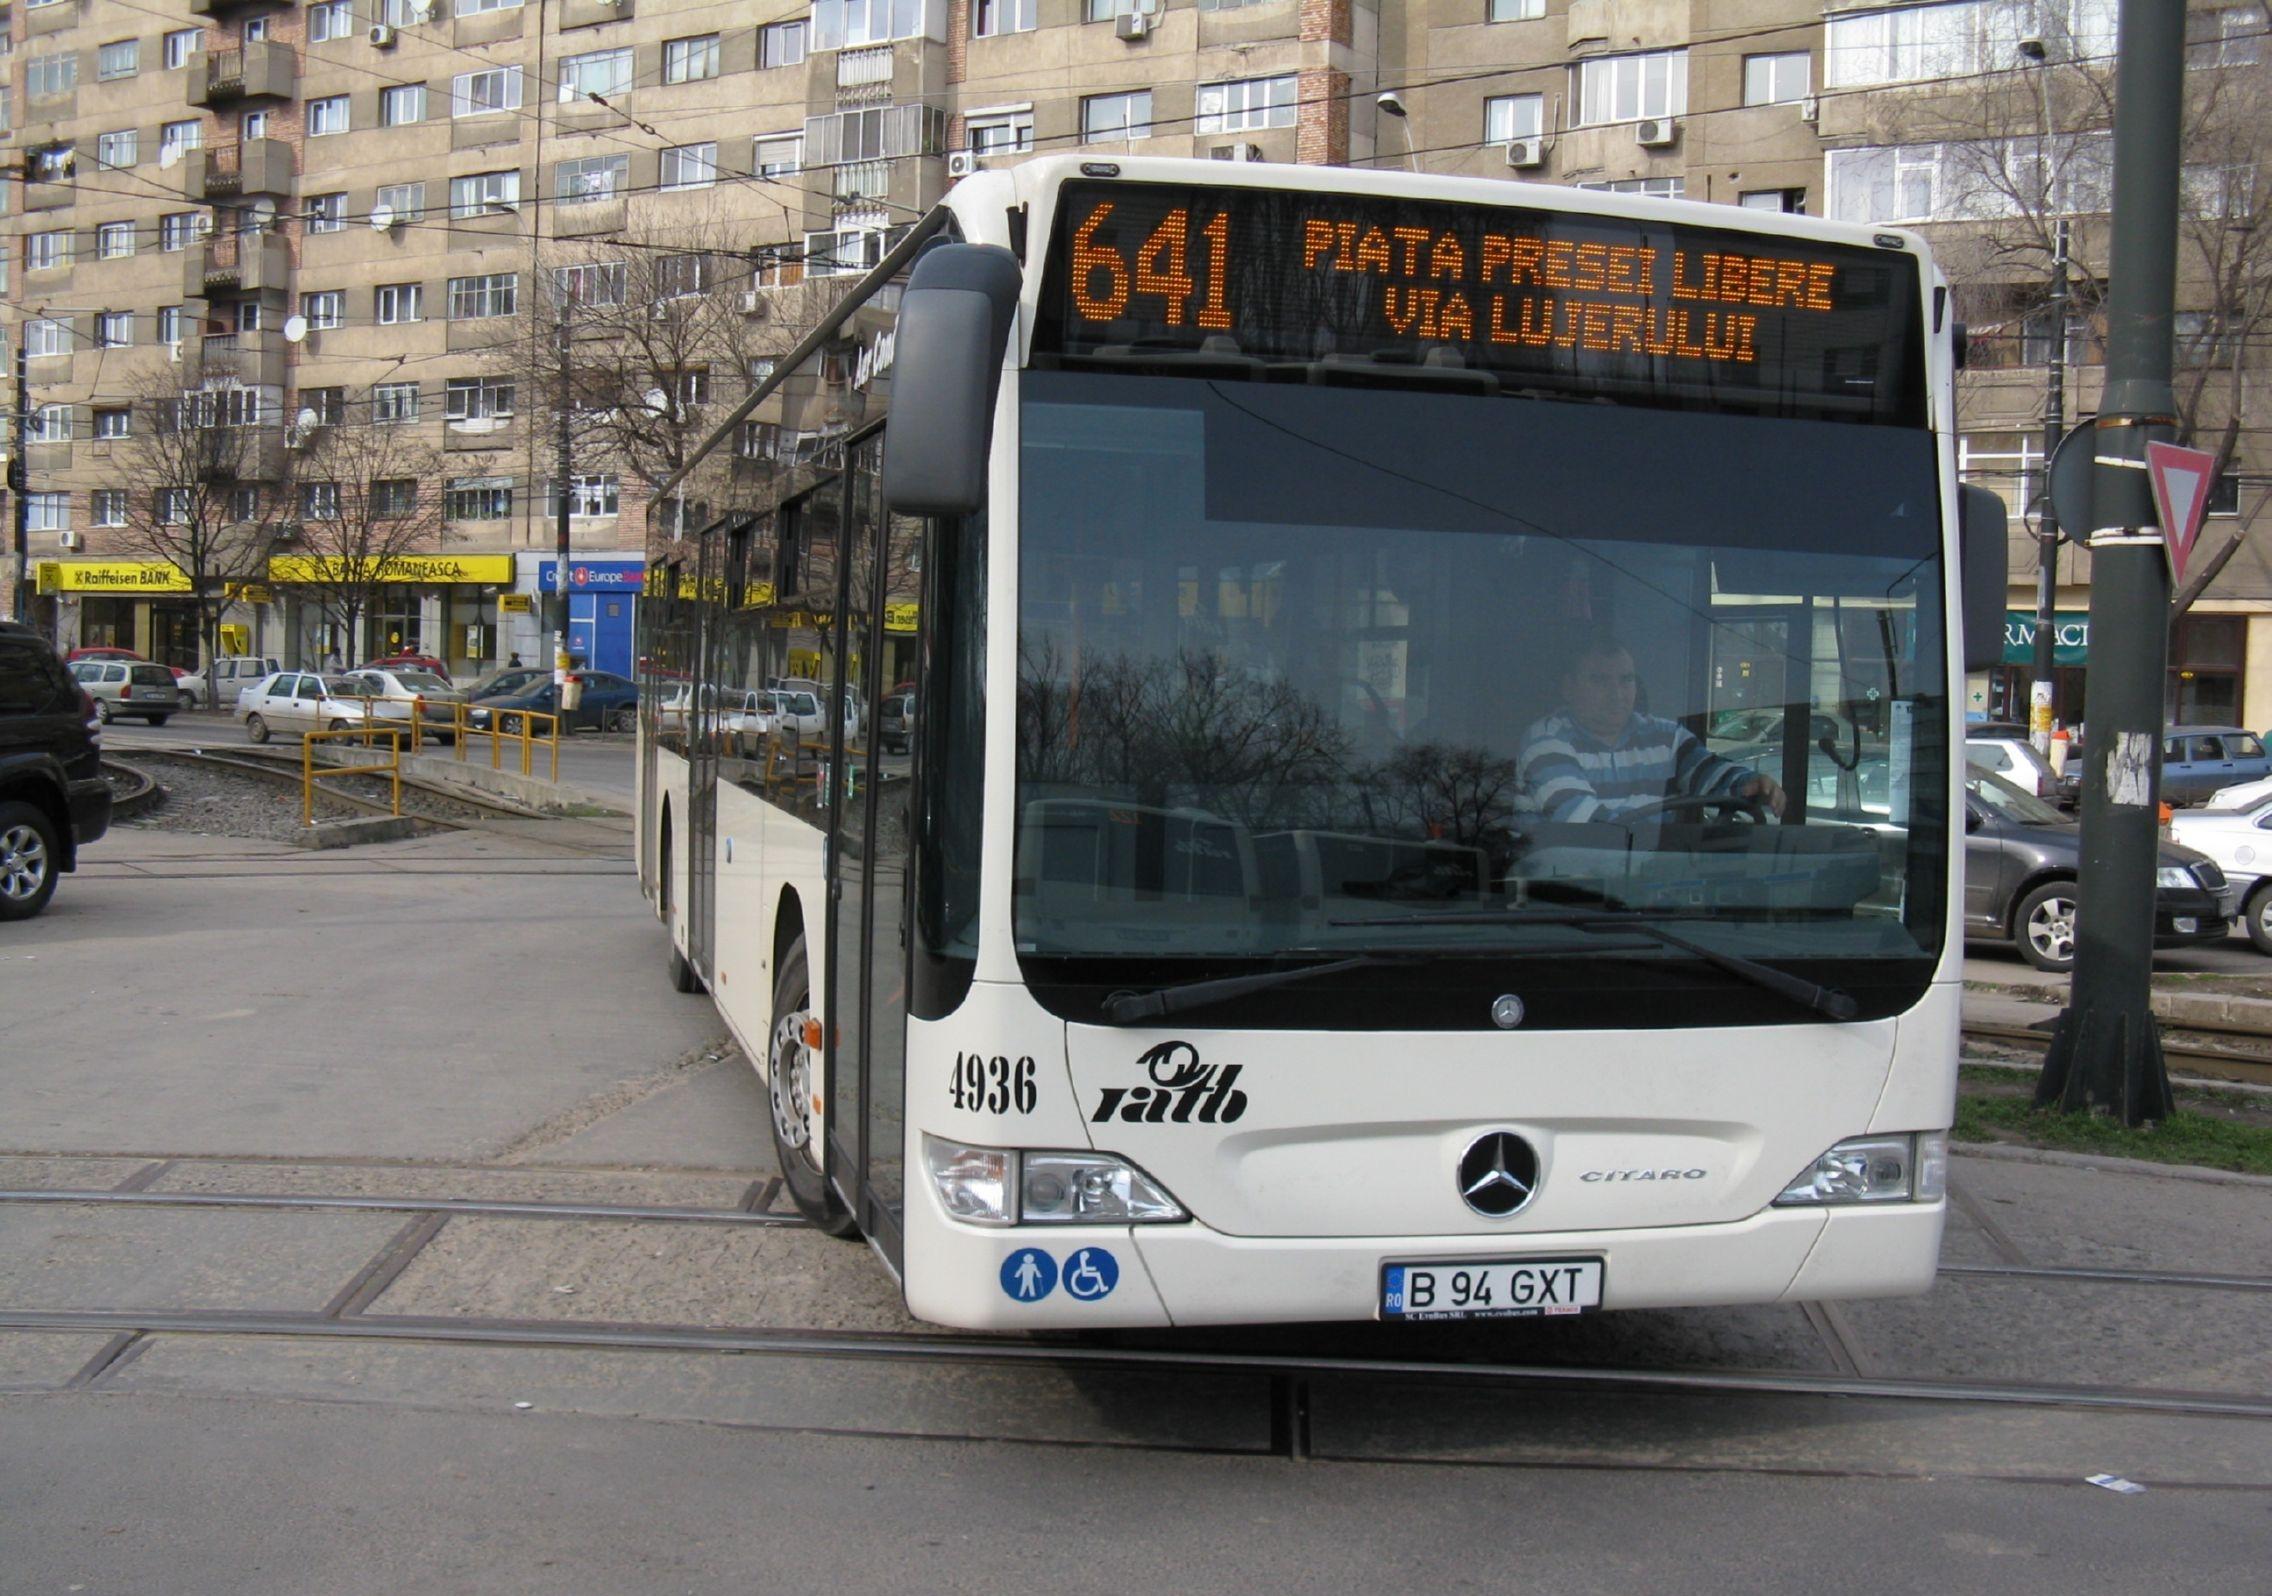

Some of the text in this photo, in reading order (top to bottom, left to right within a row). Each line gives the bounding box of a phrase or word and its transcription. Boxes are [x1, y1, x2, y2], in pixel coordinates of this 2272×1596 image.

[1072, 202, 1232, 329] 641
[1304, 218, 1835, 310] PIATA PRESEI LIBERE
[1385, 287, 1756, 361] VIA LUJERULUI
[84, 570, 171, 585] Raiffeisen BANK
[588, 570, 623, 584] Europe
[949, 1050, 1037, 1115] 4936
[1579, 1168, 1707, 1183] CITARO
[1385, 1292, 1401, 1309] RO
[1409, 1268, 1583, 1307] B 94 GXT
